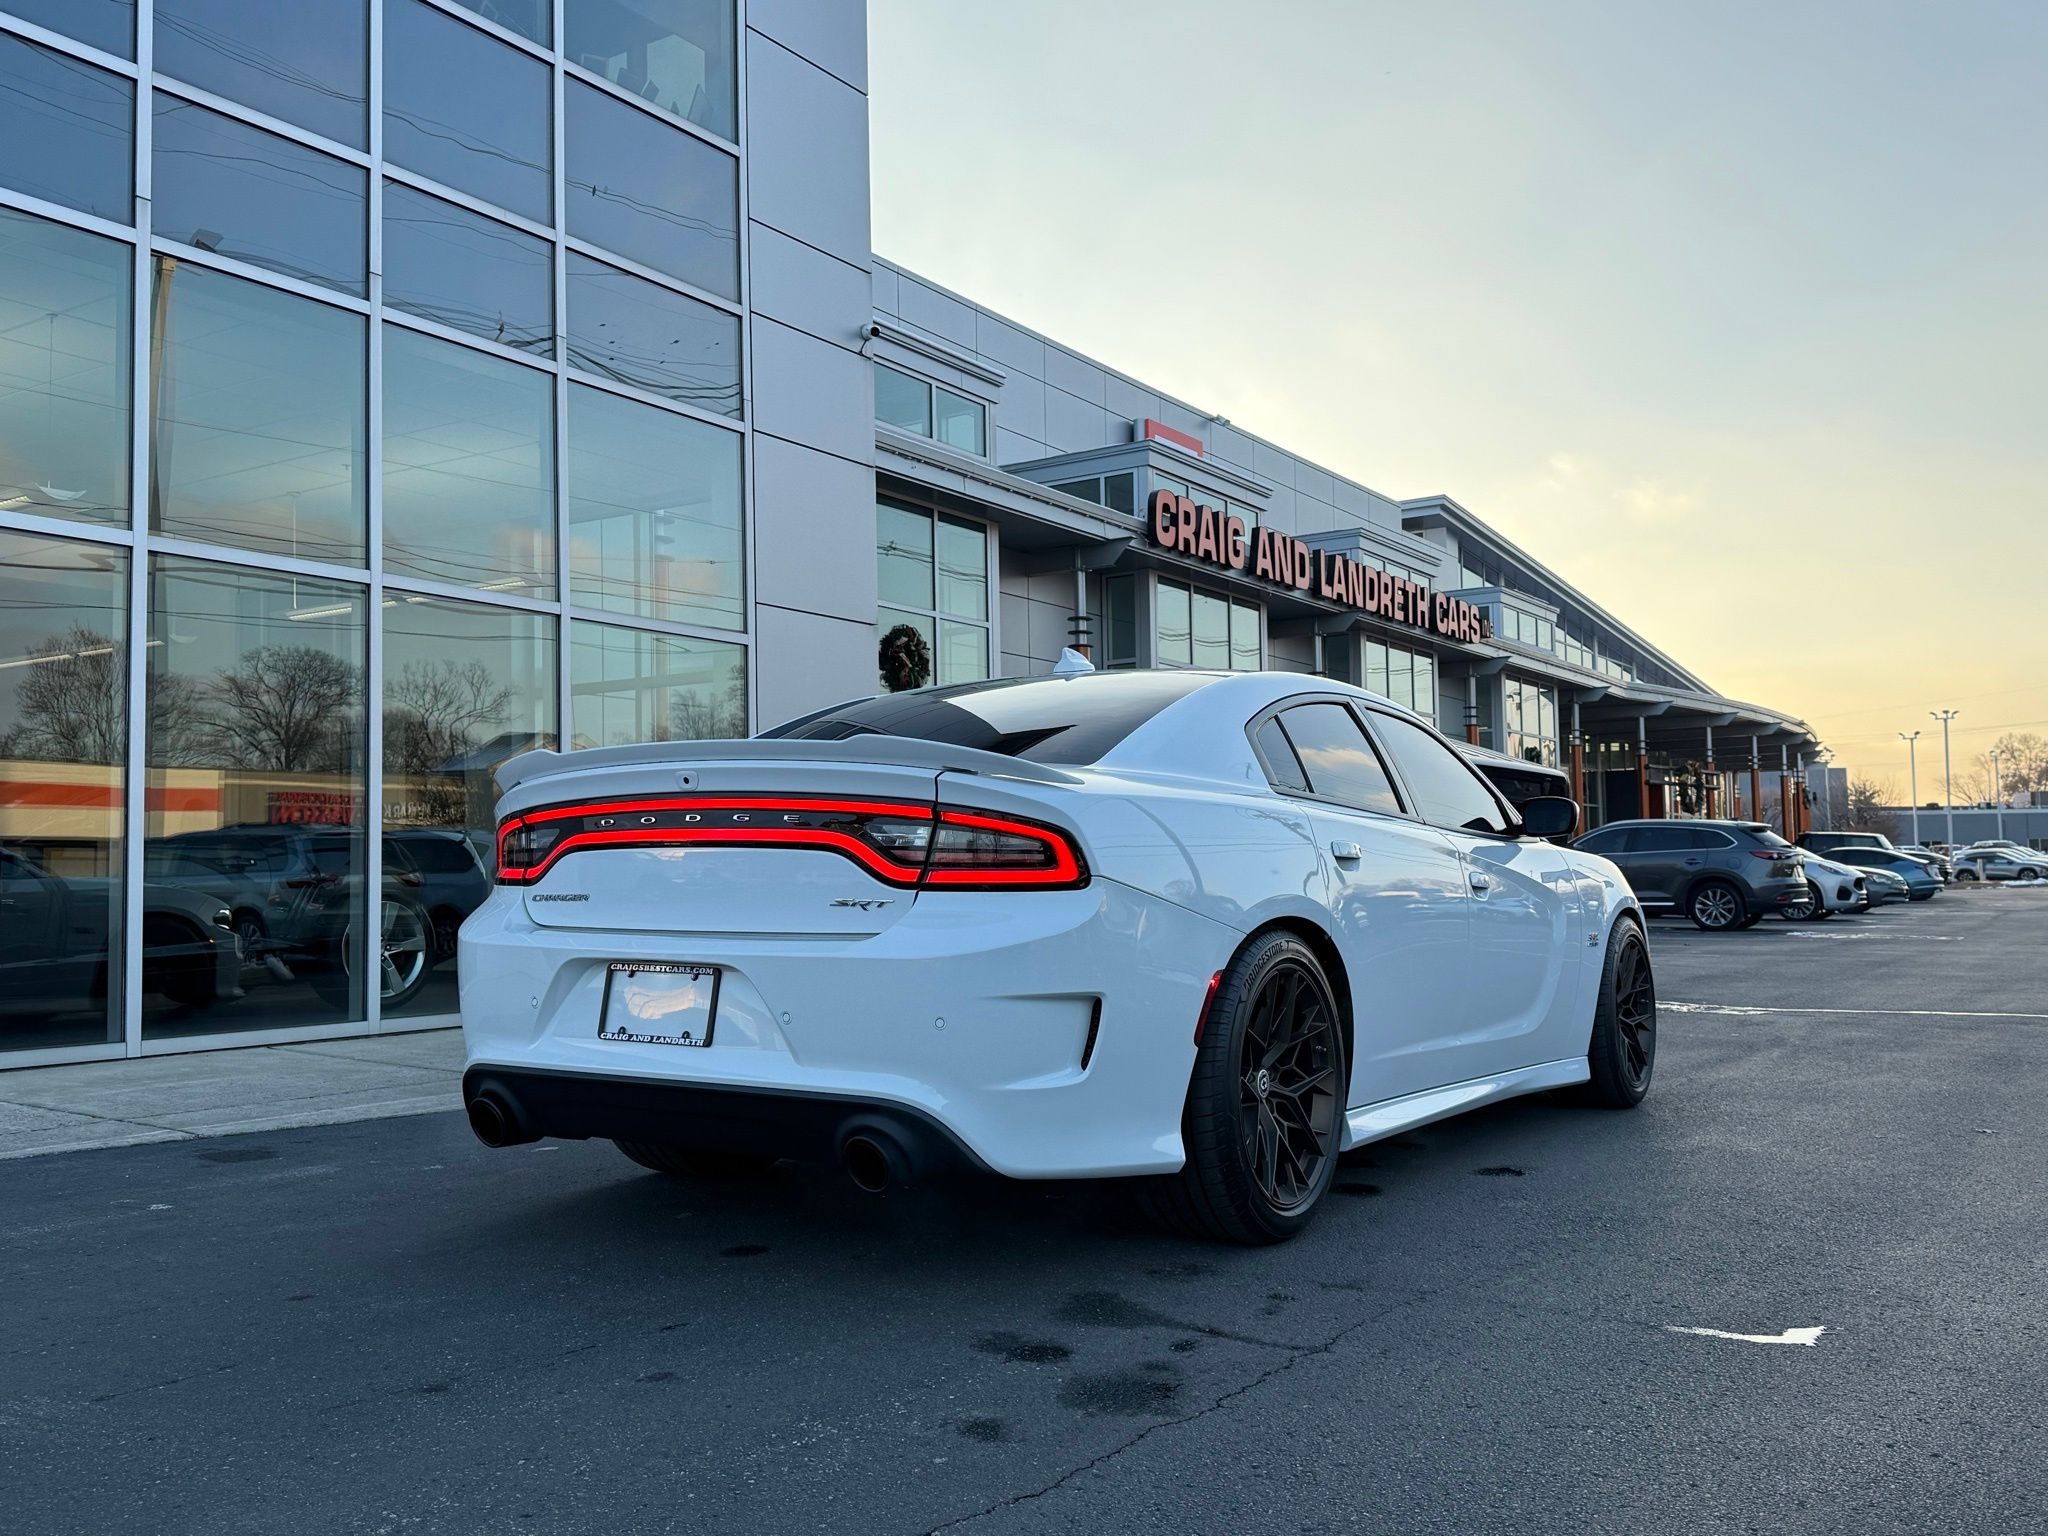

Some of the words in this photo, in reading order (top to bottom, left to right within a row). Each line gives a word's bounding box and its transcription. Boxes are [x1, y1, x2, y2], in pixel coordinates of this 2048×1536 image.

[1151, 488, 1246, 570] CRAIG
[1253, 526, 1310, 590] AND
[1317, 548, 1430, 629] LANDRETH
[1434, 591, 1481, 644] CARS
[600, 813, 801, 827] DODGE
[531, 894, 591, 903] CHARGER
[829, 897, 895, 912] SRT
[610, 963, 713, 974] CRAIGSBESTCARS.COM
[1243, 940, 1284, 992] BRIDGESTONE
[600, 1032, 629, 1041] CRAIG
[630, 1034, 651, 1043] AND
[653, 1036, 704, 1046] LANDRETH
